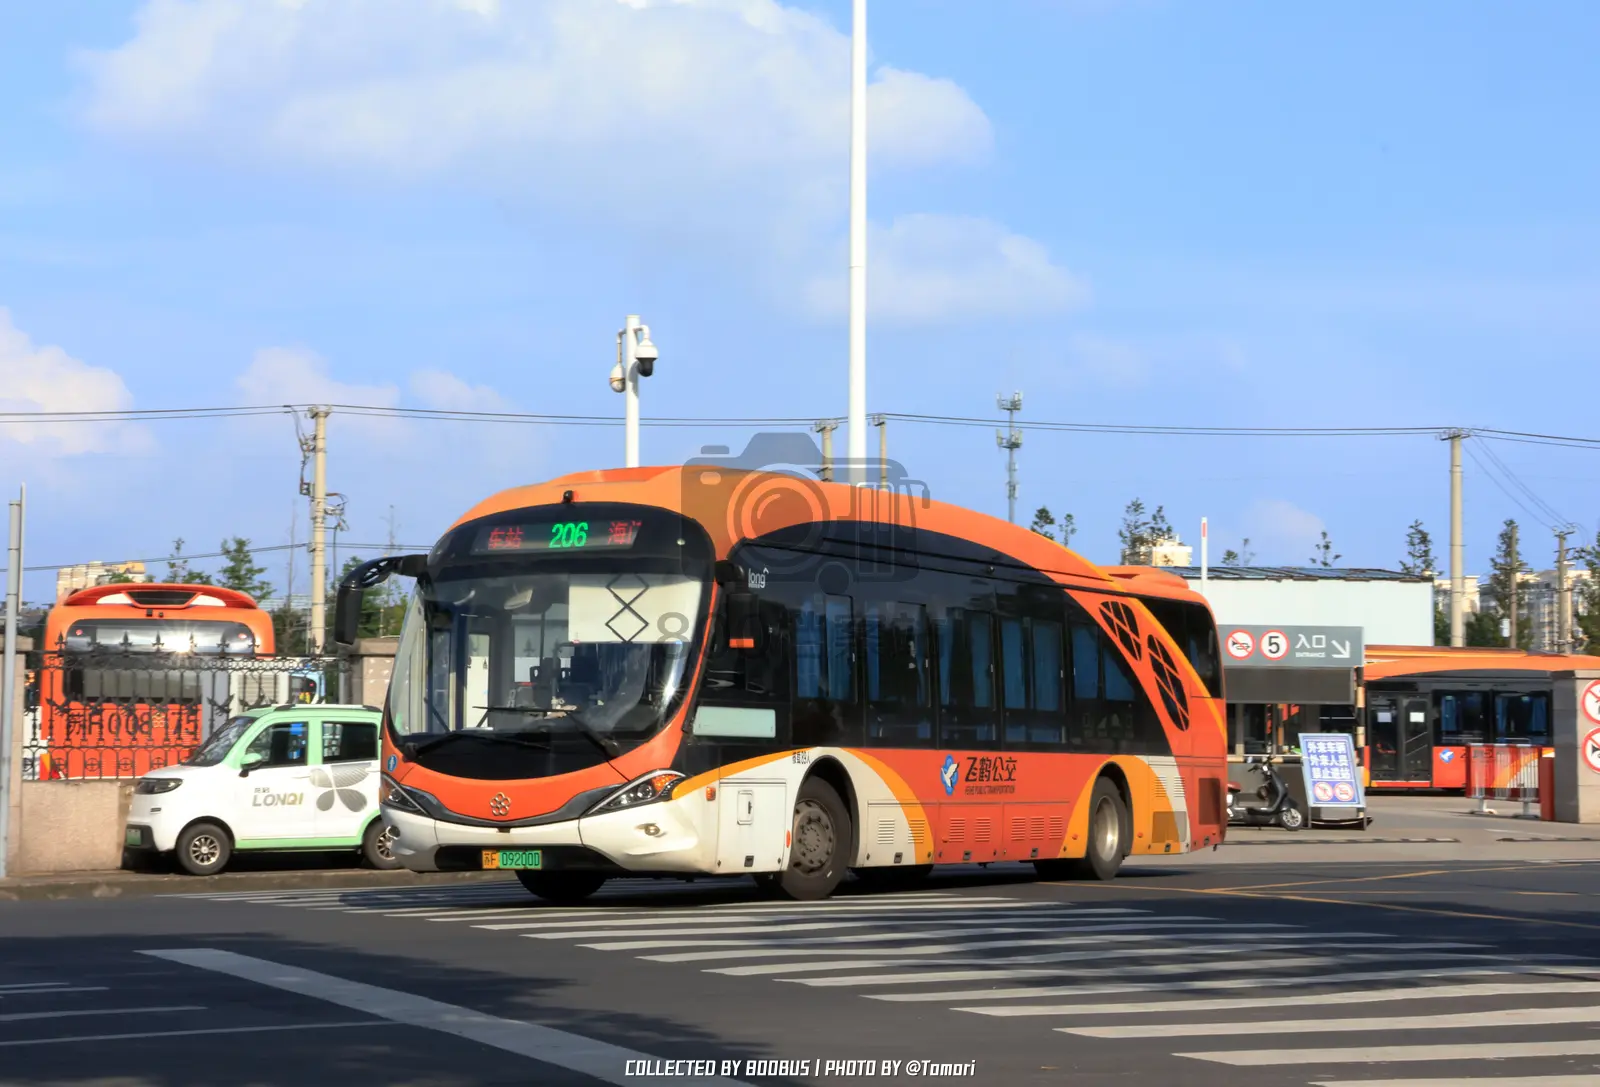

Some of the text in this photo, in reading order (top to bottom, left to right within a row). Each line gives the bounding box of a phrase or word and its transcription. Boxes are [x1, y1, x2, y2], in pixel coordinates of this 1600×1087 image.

[548, 521, 589, 549] 206
[1267, 633, 1327, 655] 5 入口
[964, 755, 1018, 783] 飞鹤公交
